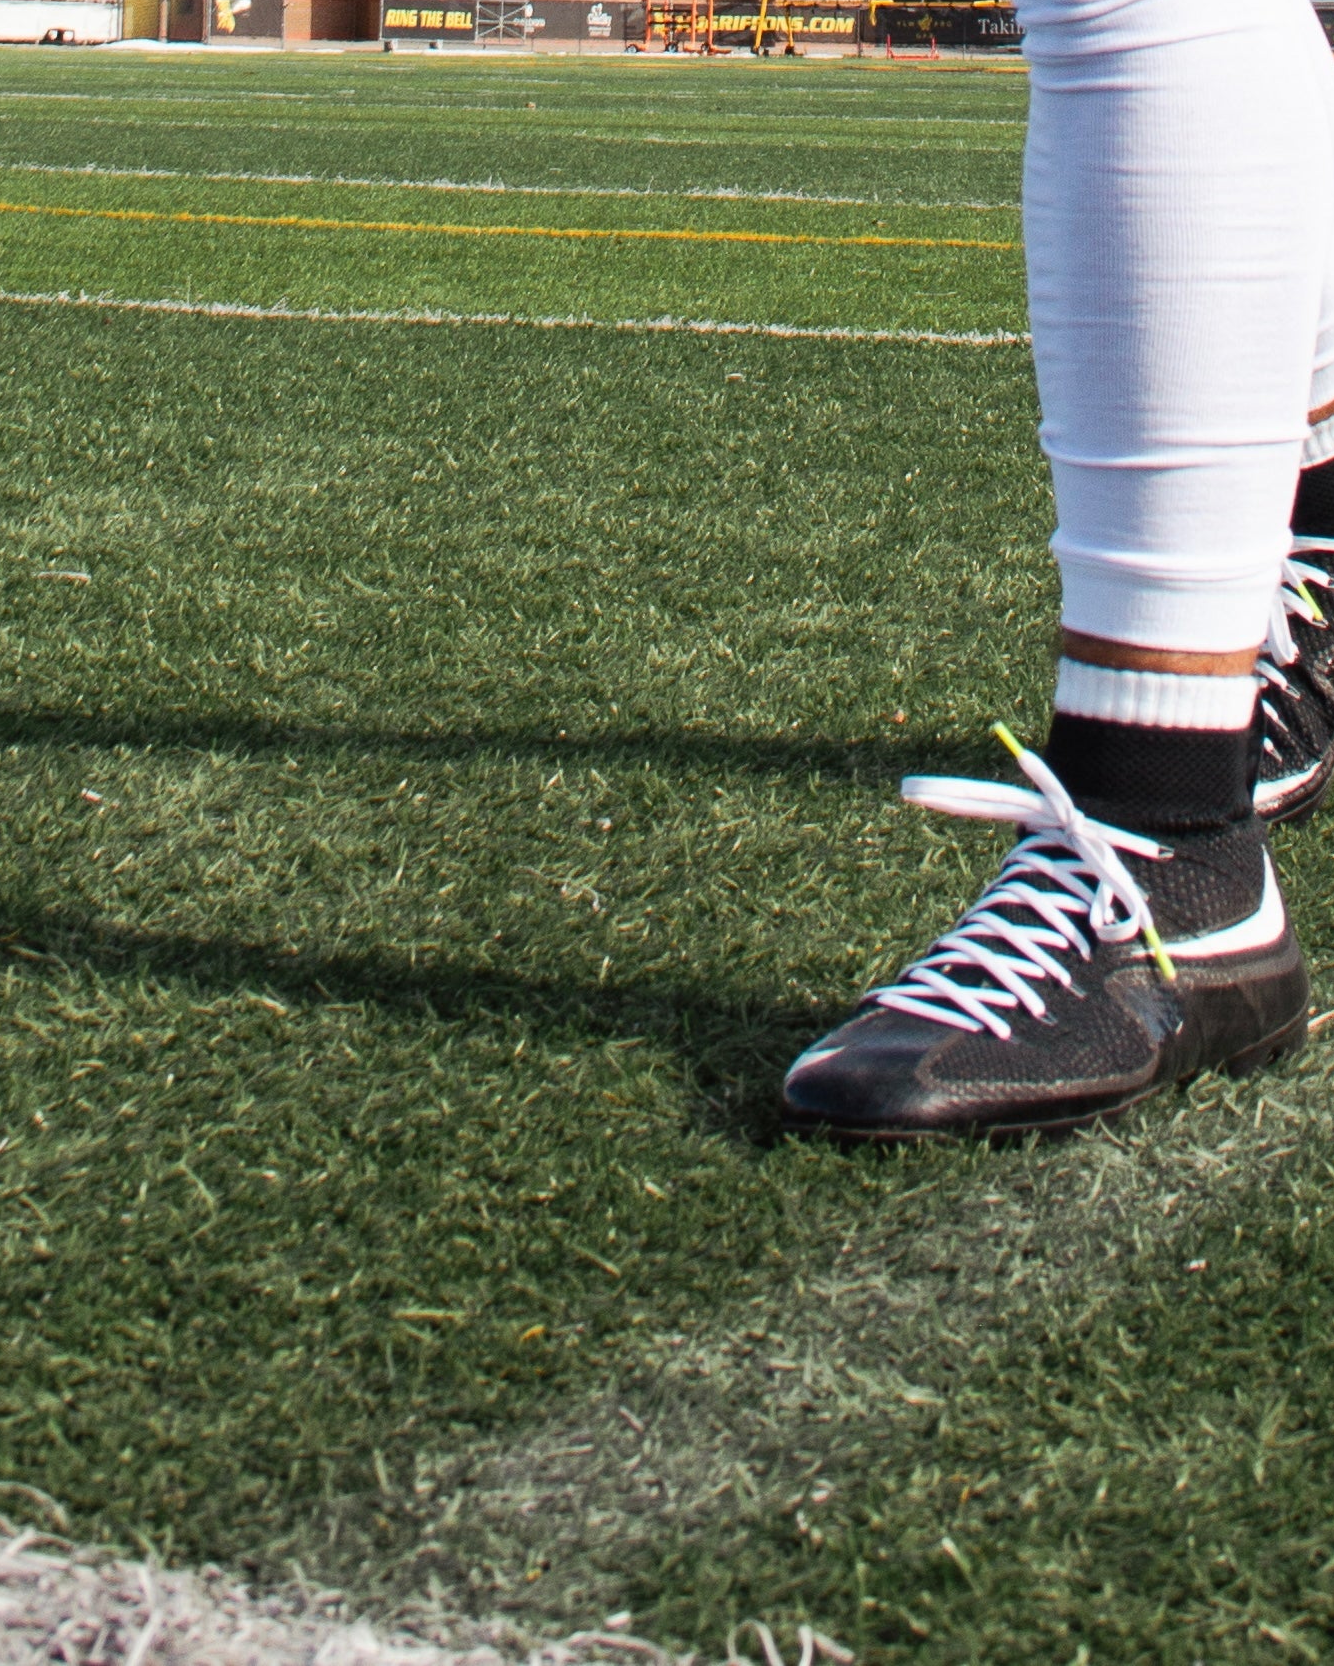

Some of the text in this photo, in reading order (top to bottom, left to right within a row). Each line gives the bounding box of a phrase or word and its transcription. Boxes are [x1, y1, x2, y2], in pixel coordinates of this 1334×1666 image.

[384, 8, 474, 30] RING THE BELL
[977, 17, 1027, 35] Takin
